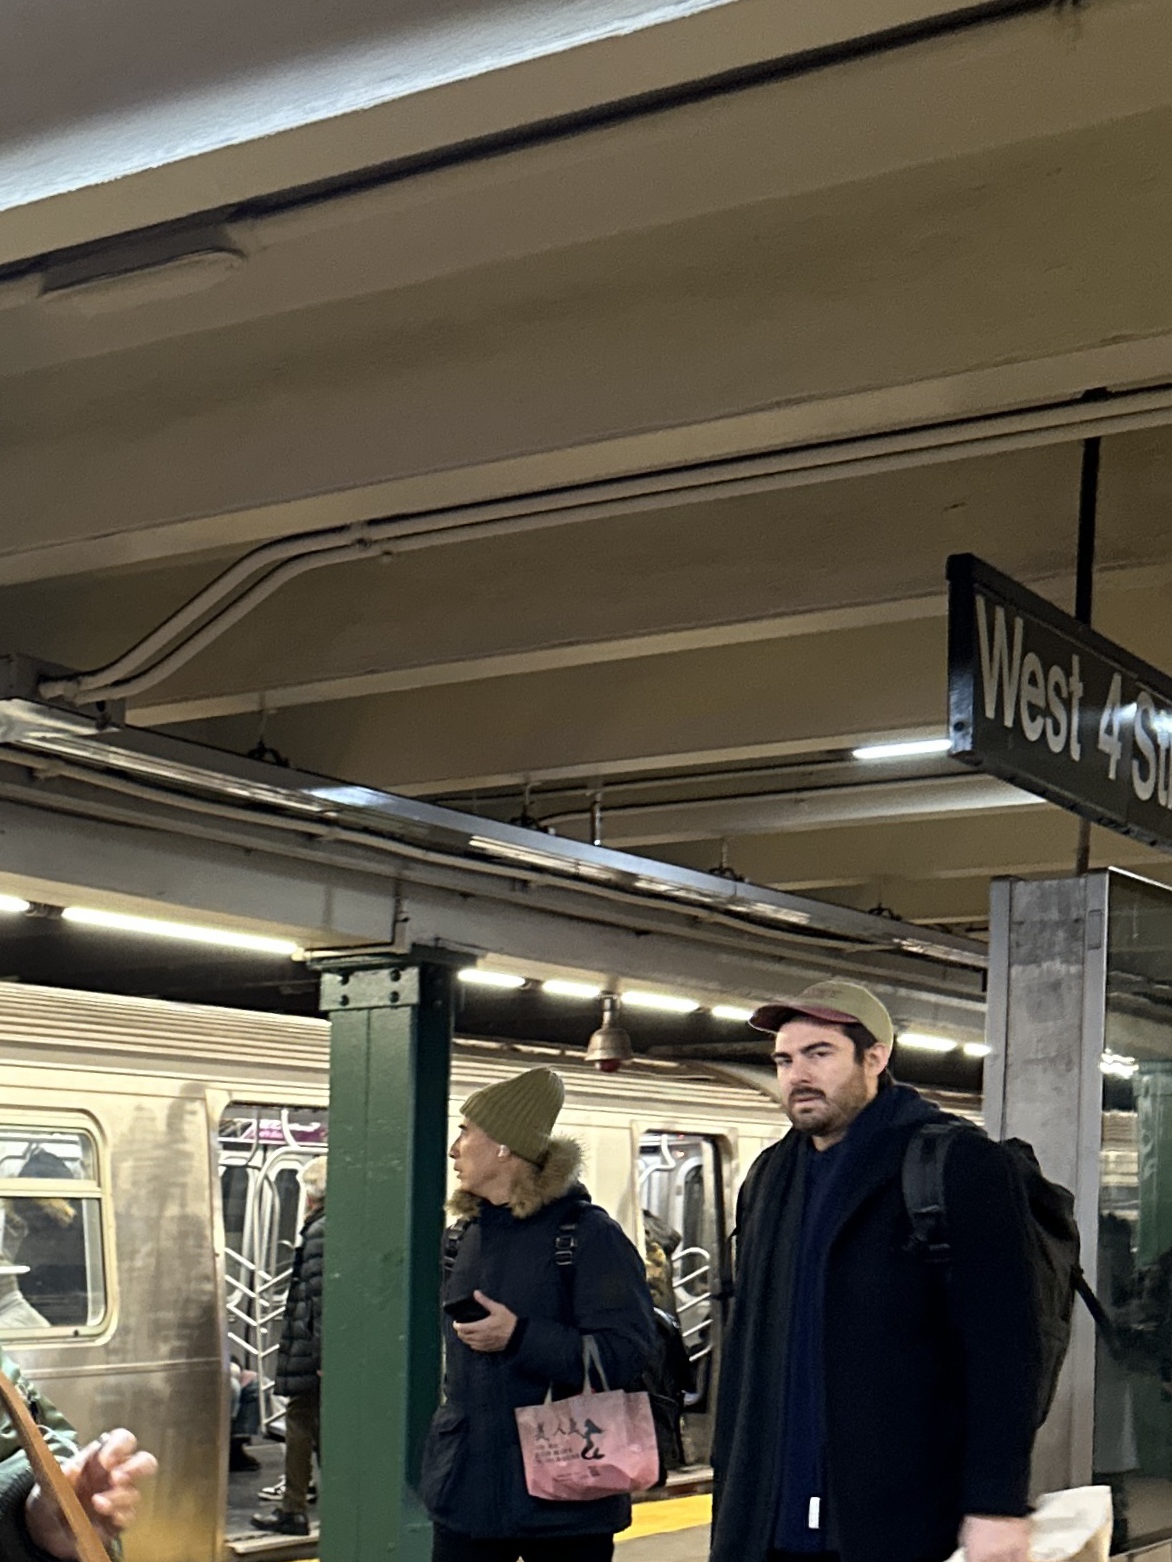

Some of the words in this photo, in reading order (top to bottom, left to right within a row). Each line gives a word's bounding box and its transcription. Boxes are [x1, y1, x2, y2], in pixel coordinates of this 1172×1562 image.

[975, 594, 1084, 762] West
[1098, 672, 1122, 781] 4
[1131, 690, 1172, 810] St
